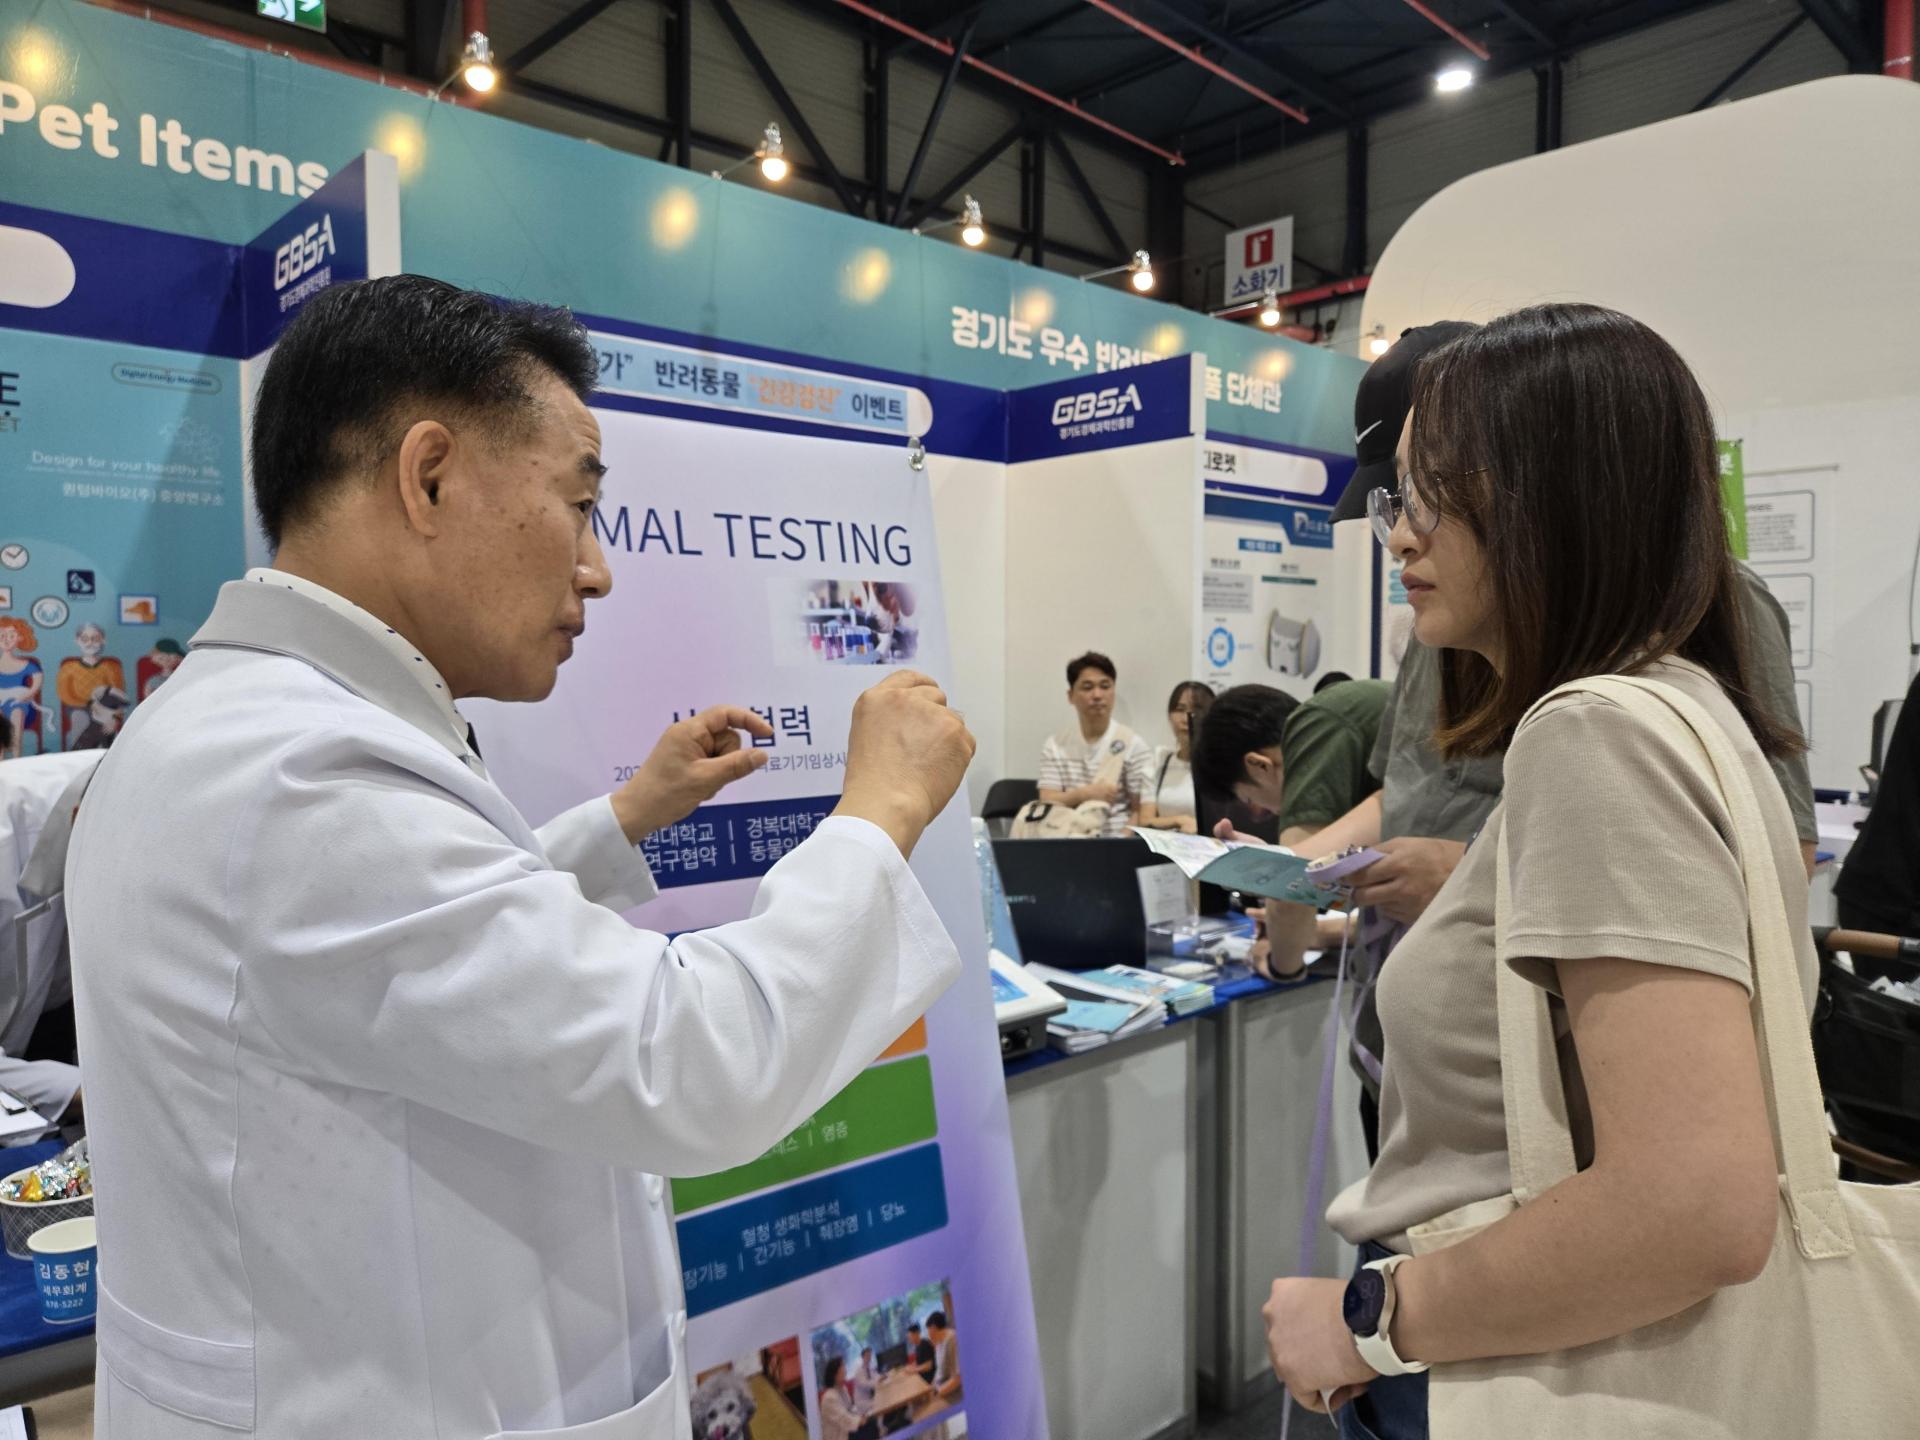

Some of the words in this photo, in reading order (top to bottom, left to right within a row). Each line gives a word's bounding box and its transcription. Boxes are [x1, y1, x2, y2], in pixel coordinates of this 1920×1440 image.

[0, 80, 119, 159] Pet
[140, 113, 329, 199] Items
[275, 213, 336, 291] GBSA
[1232, 264, 1284, 297] 소화기
[952, 306, 1033, 360] 경기도
[1040, 327, 1089, 371] 우수
[1096, 340, 1165, 374] 반려
[655, 361, 741, 399] 반려동물
[852, 393, 904, 421] 이벤트
[1052, 383, 1142, 426] GBSA
[32, 450, 84, 468] Design
[88, 455, 106, 468] for
[111, 458, 143, 473] your
[713, 512, 912, 567] TESTING
[673, 704, 812, 748] 협력
[762, 752, 848, 773] 료기기임상시
[750, 834, 807, 863] 동물
[40, 1260, 90, 1280] 김동현
[754, 1239, 795, 1266] 간기능
